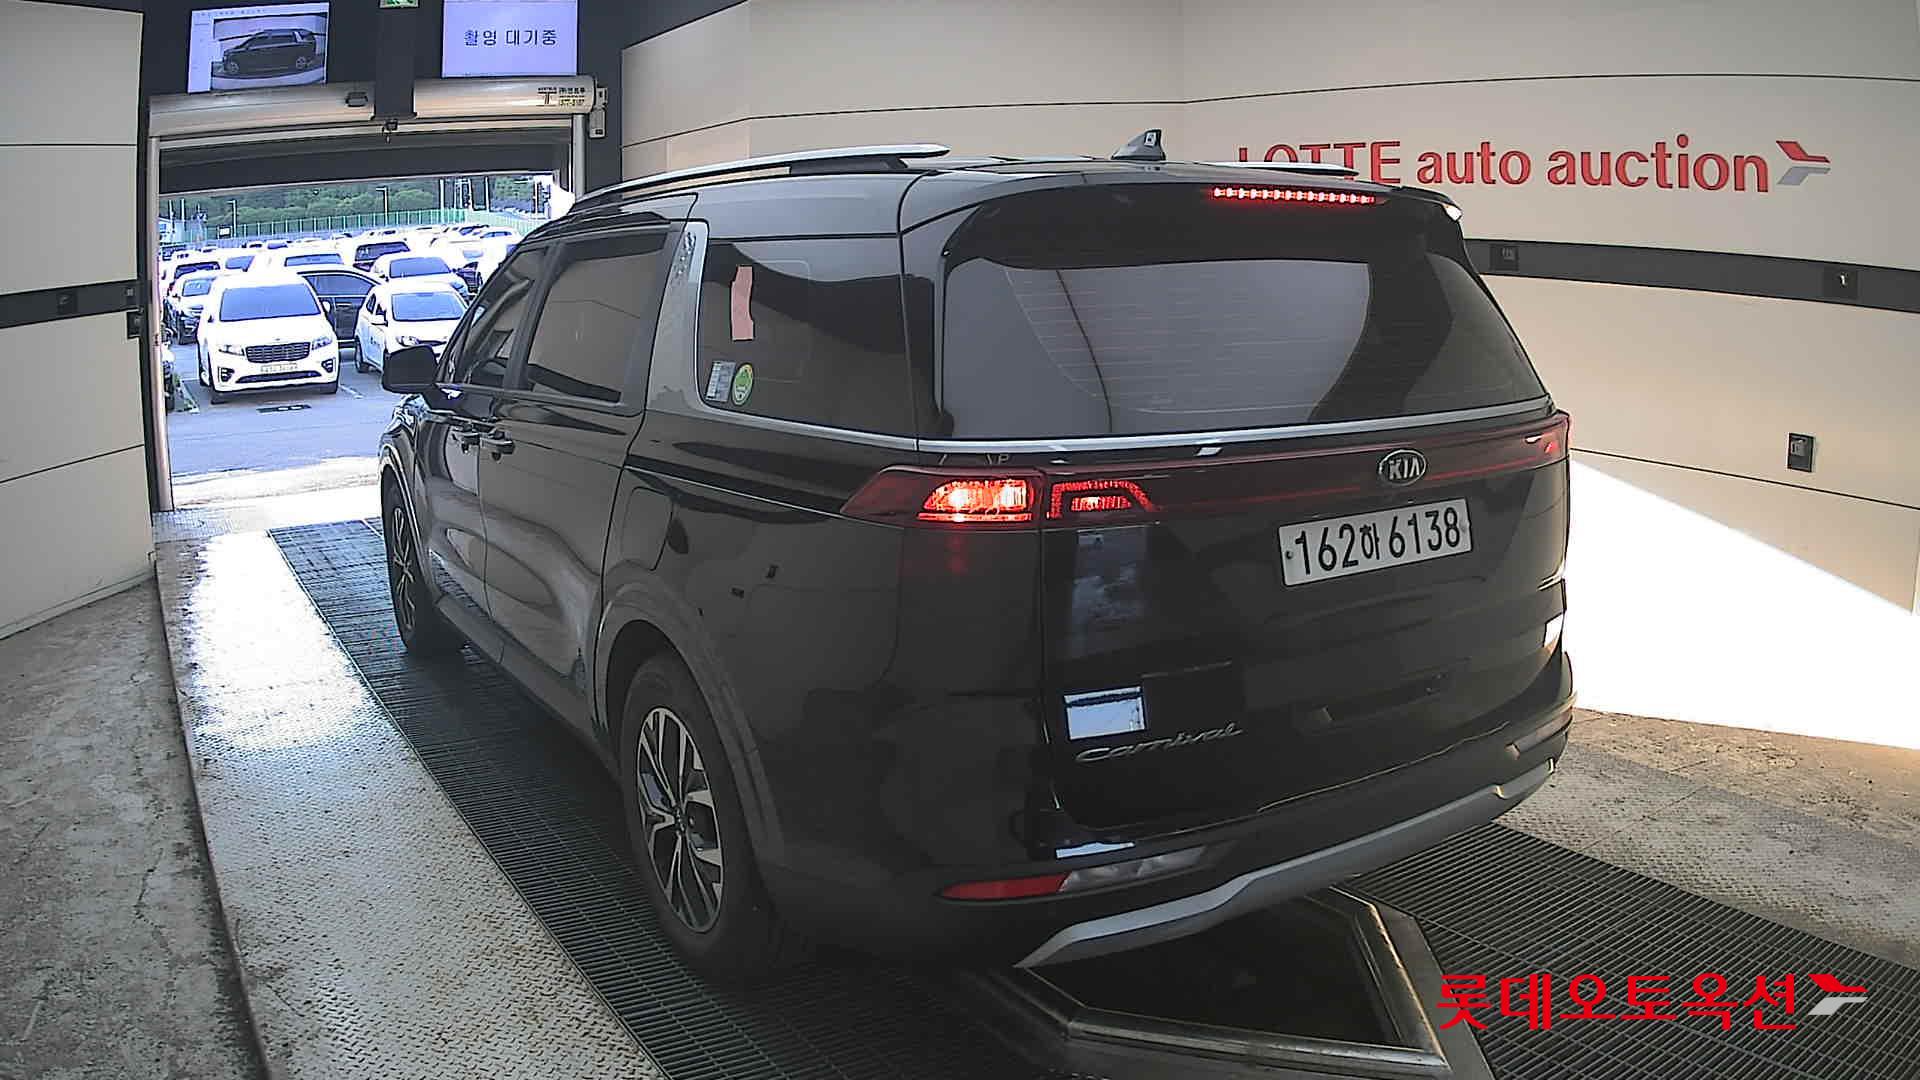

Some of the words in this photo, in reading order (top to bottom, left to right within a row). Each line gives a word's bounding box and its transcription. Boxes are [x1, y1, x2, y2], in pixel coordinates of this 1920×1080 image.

[506, 29, 557, 46] 대기중
[1417, 142, 1532, 186] auto
[1547, 133, 1771, 193] auction
[1388, 457, 1421, 481] KIA
[1295, 523, 1381, 575] 162하
[1388, 507, 1461, 559] 6138
[1075, 722, 1244, 764] Carnival
